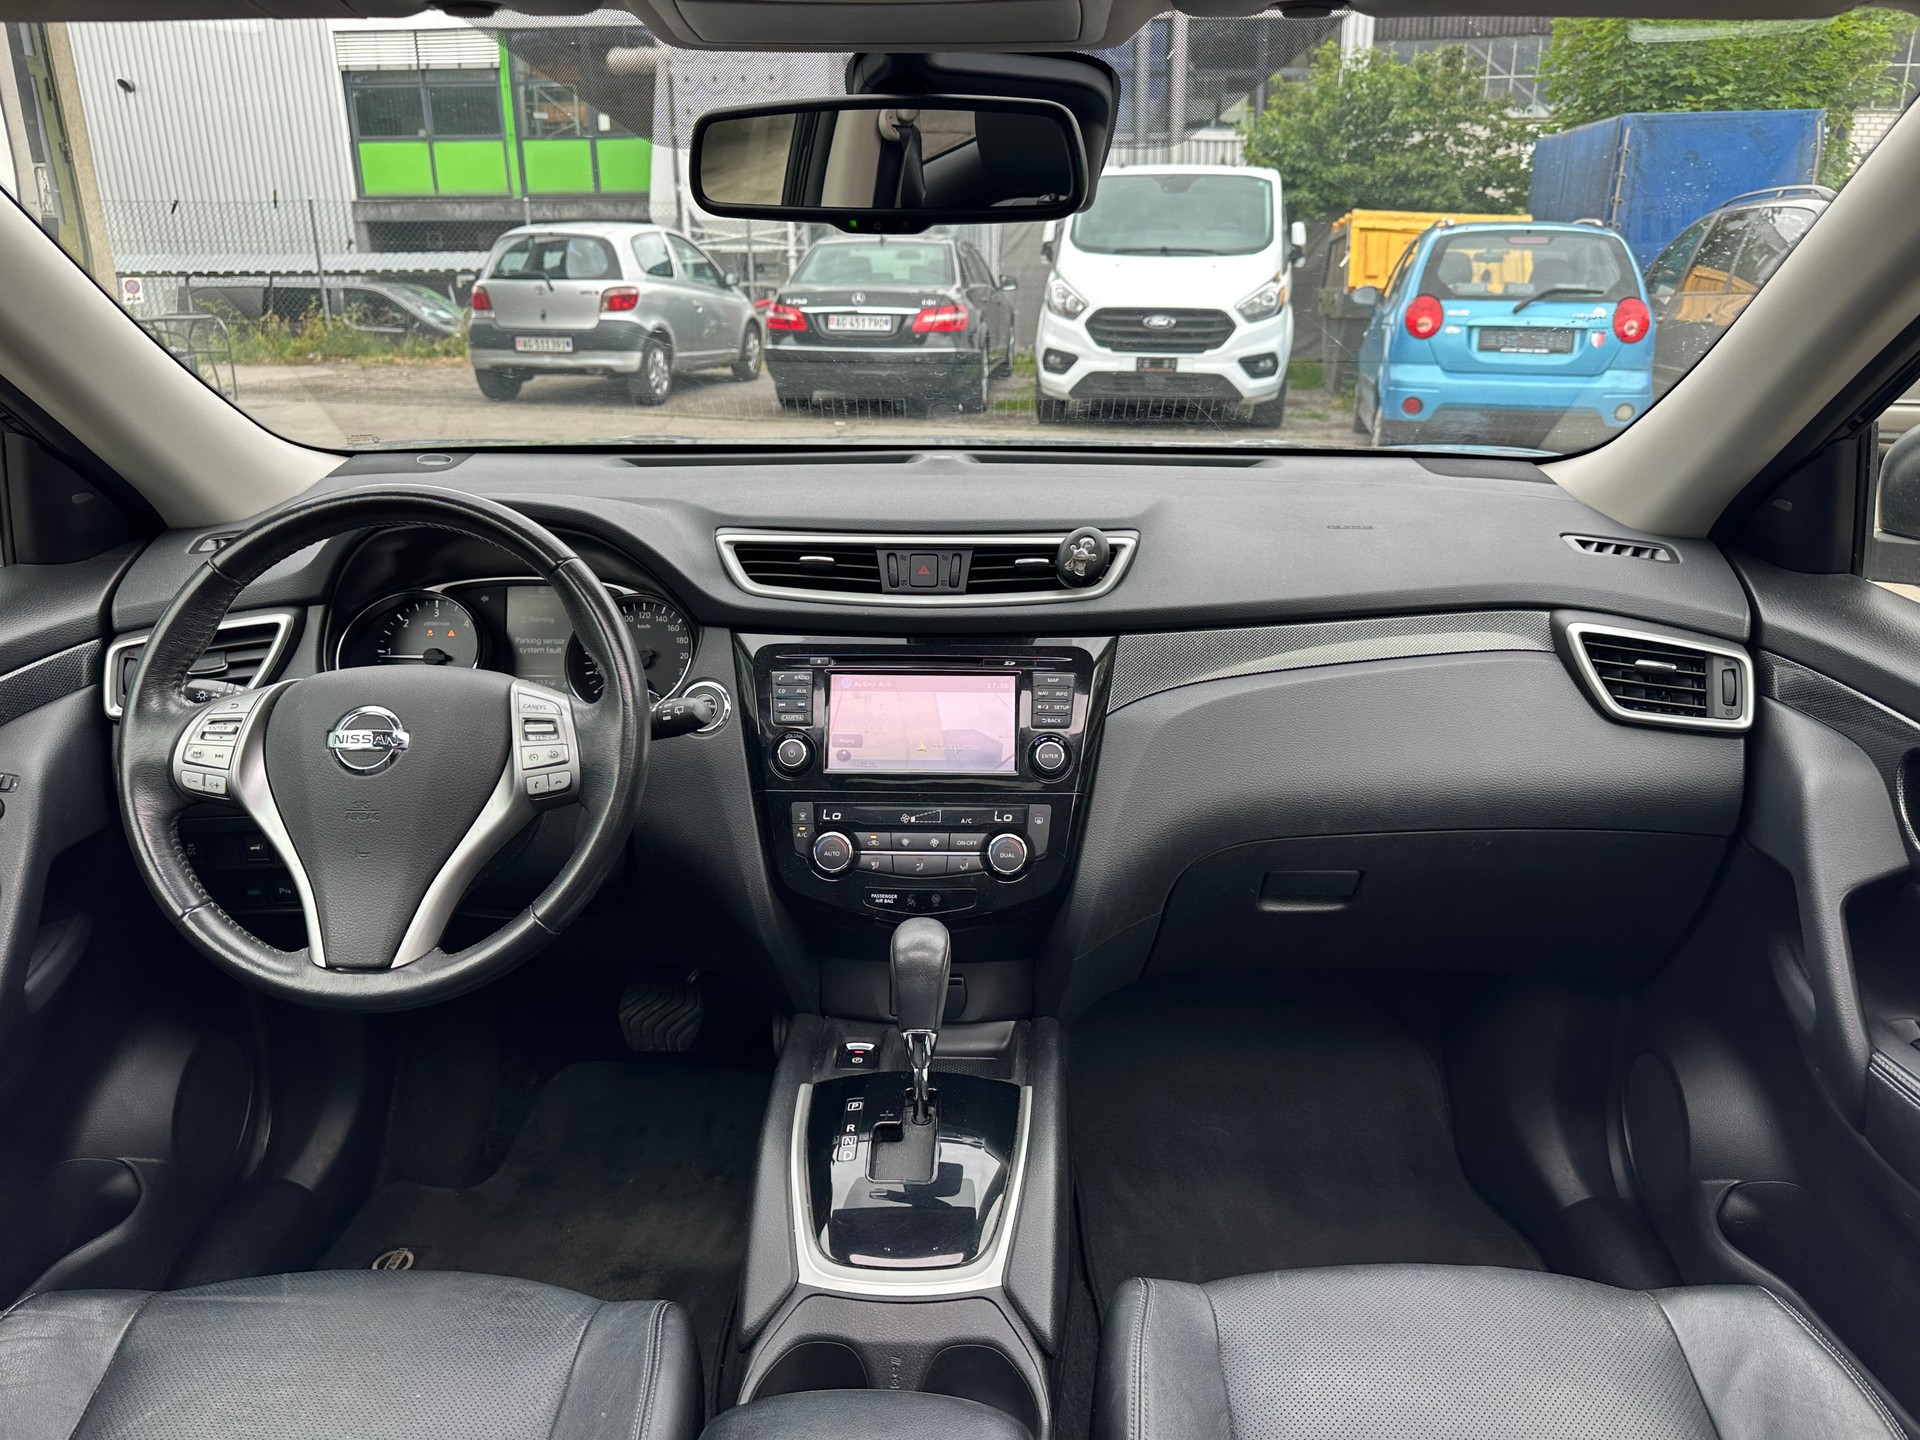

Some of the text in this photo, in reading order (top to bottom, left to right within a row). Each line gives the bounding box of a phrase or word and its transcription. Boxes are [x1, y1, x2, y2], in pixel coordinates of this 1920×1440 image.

[433, 609, 440, 617] 3
[403, 619, 409, 628] 2
[463, 619, 470, 628] 4
[515, 636, 541, 646] Parking
[519, 646, 562, 655] system fault
[333, 734, 399, 747] NISSAN
[822, 808, 842, 821] Lo
[994, 810, 1013, 822] Lo
[846, 1123, 856, 1133] R
[843, 1151, 853, 1161] D
